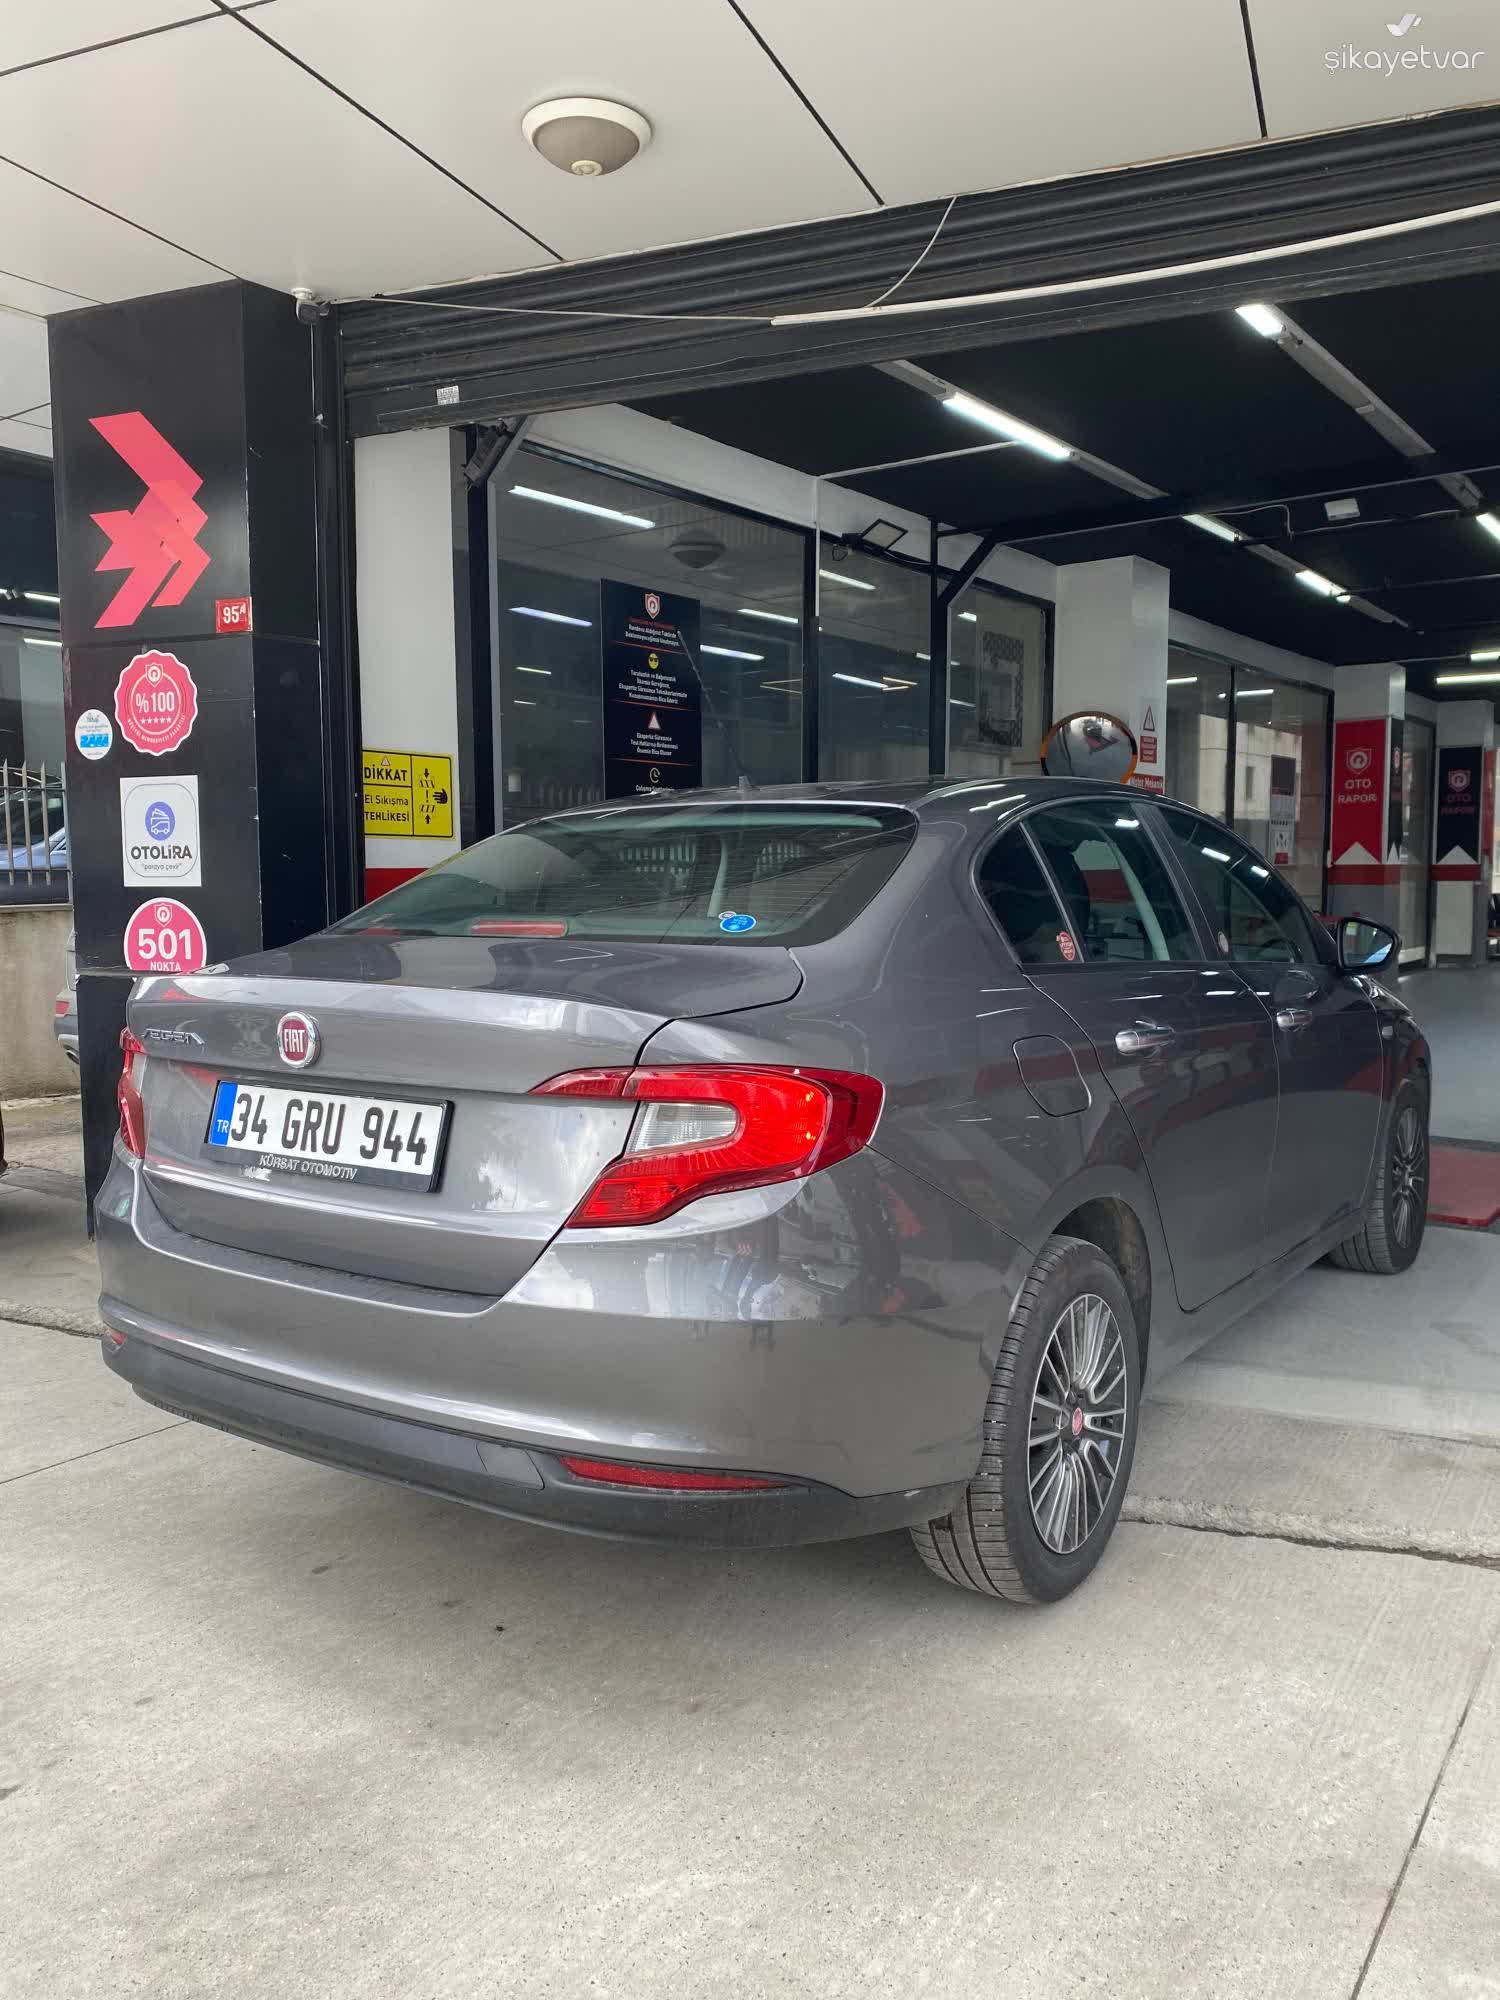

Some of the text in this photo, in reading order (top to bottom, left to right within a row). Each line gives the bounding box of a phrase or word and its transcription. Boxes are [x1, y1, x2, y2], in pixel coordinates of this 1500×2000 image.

[364, 764, 407, 782] DİKKAT
[1344, 778, 1371, 790] OTO
[365, 794, 408, 806] El Sıkışma
[1338, 793, 1377, 806] RAPOR
[365, 810, 409, 822] TEHLİKESİ
[138, 928, 192, 960] 501
[150, 961, 181, 971] NOKTA
[284, 1029, 305, 1053] FIAT
[216, 1093, 427, 1165] TR 34 GRU 944
